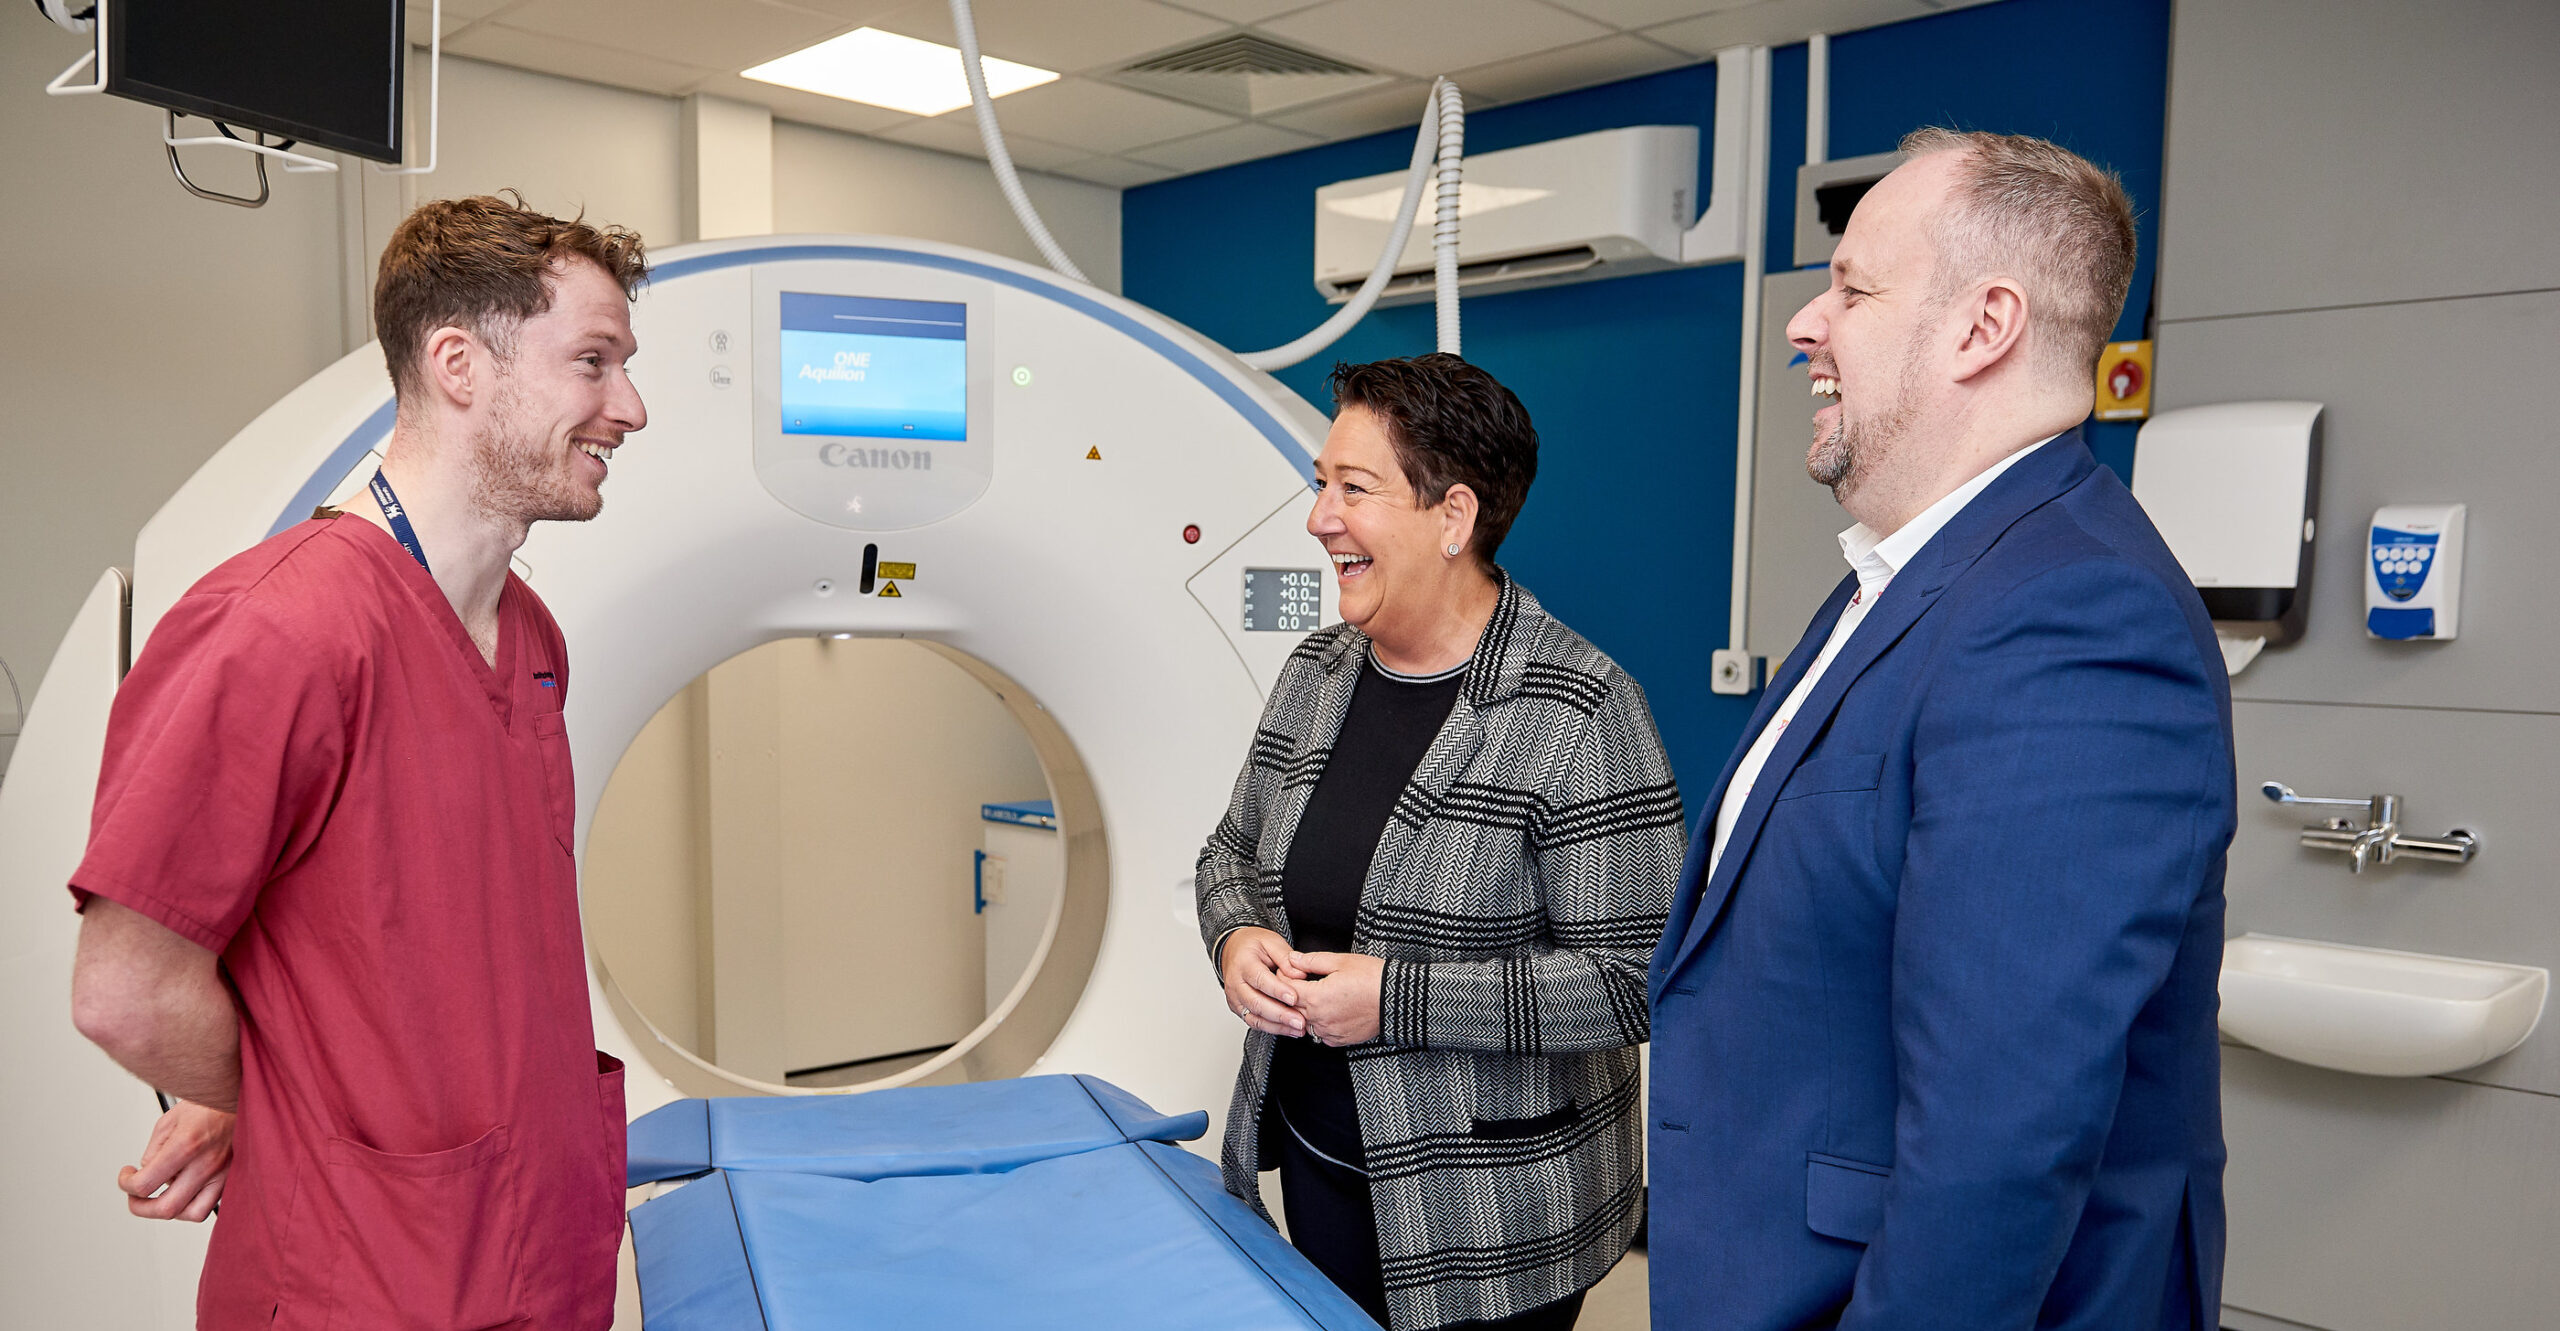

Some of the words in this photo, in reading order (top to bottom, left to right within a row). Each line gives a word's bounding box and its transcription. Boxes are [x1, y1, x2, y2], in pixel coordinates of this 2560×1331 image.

[834, 352, 871, 368] ONE
[799, 364, 866, 384] Aquilion
[819, 443, 932, 471] Canon
[1280, 573, 1310, 587] +0.0
[1280, 587, 1310, 601] +0.0
[1280, 602, 1310, 616] +0.0
[1278, 616, 1300, 630] 0.0
